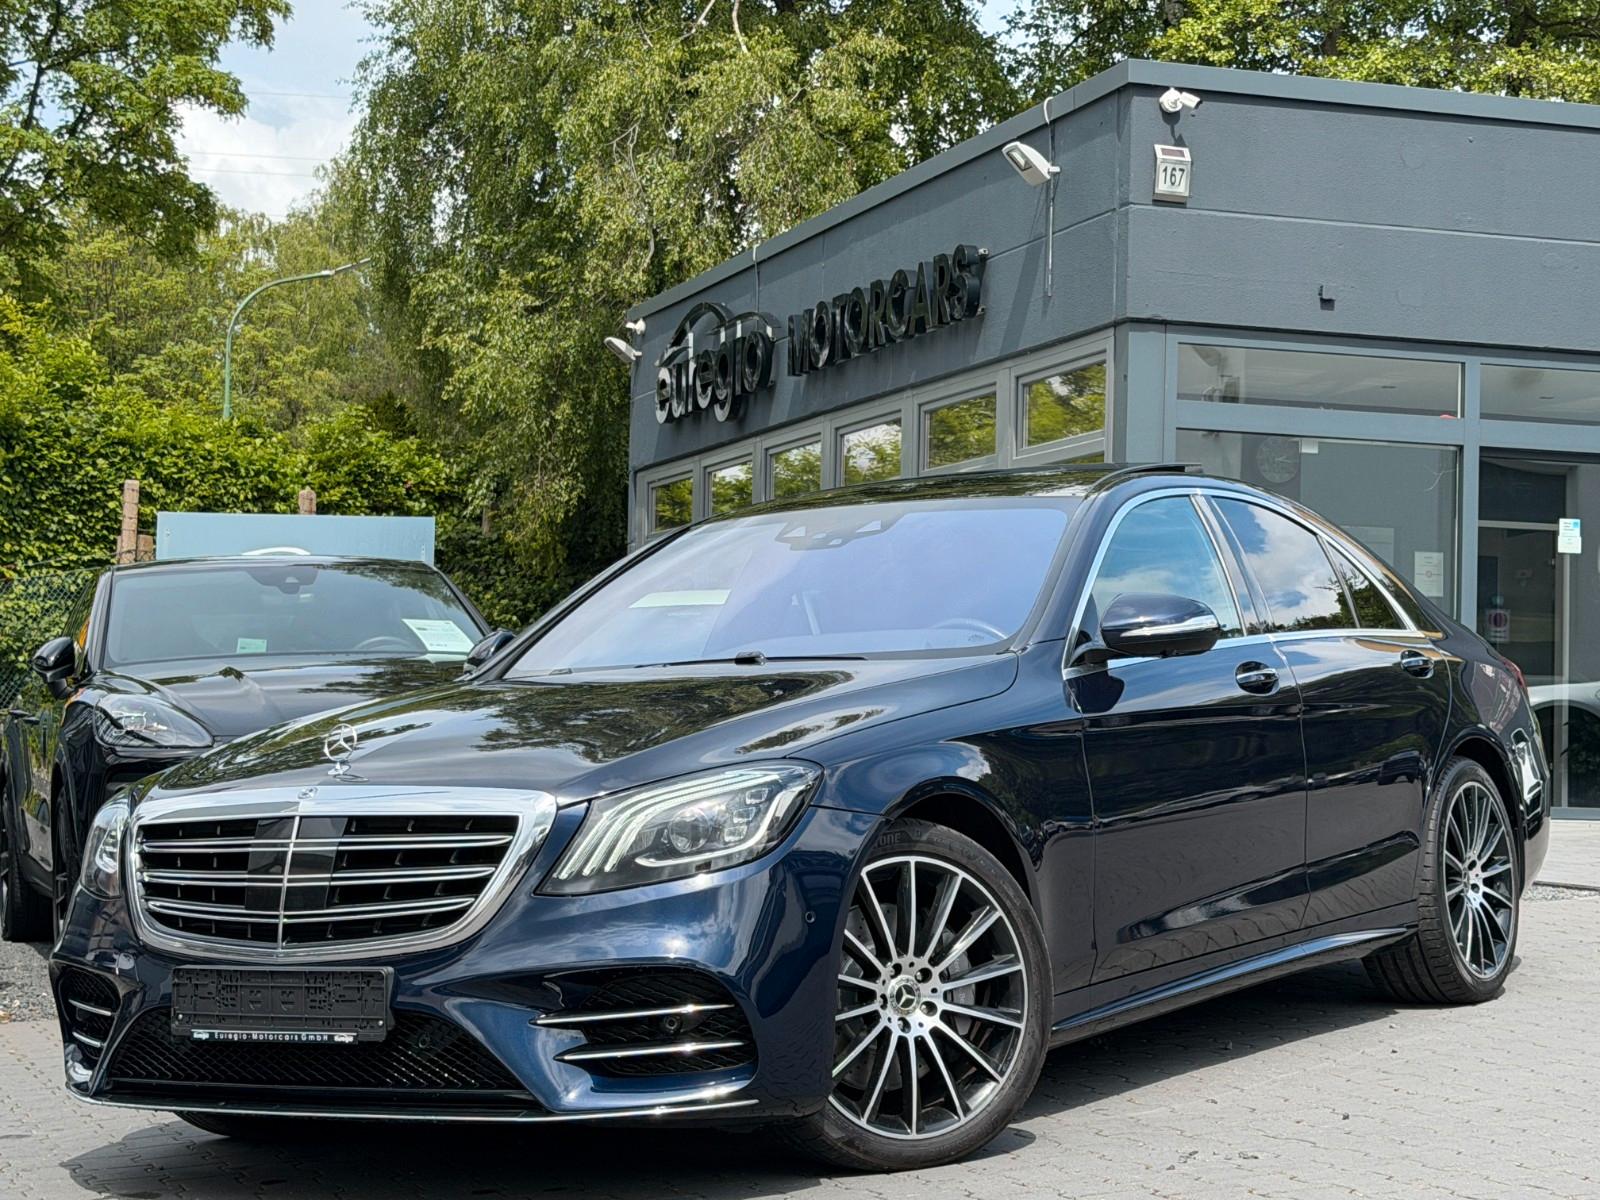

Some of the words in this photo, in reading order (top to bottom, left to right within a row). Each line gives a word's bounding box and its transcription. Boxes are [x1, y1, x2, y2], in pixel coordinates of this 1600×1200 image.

[1162, 165, 1185, 187] 167
[787, 244, 985, 376] MOTORCARS
[301, 1033, 328, 1041] GmbH
